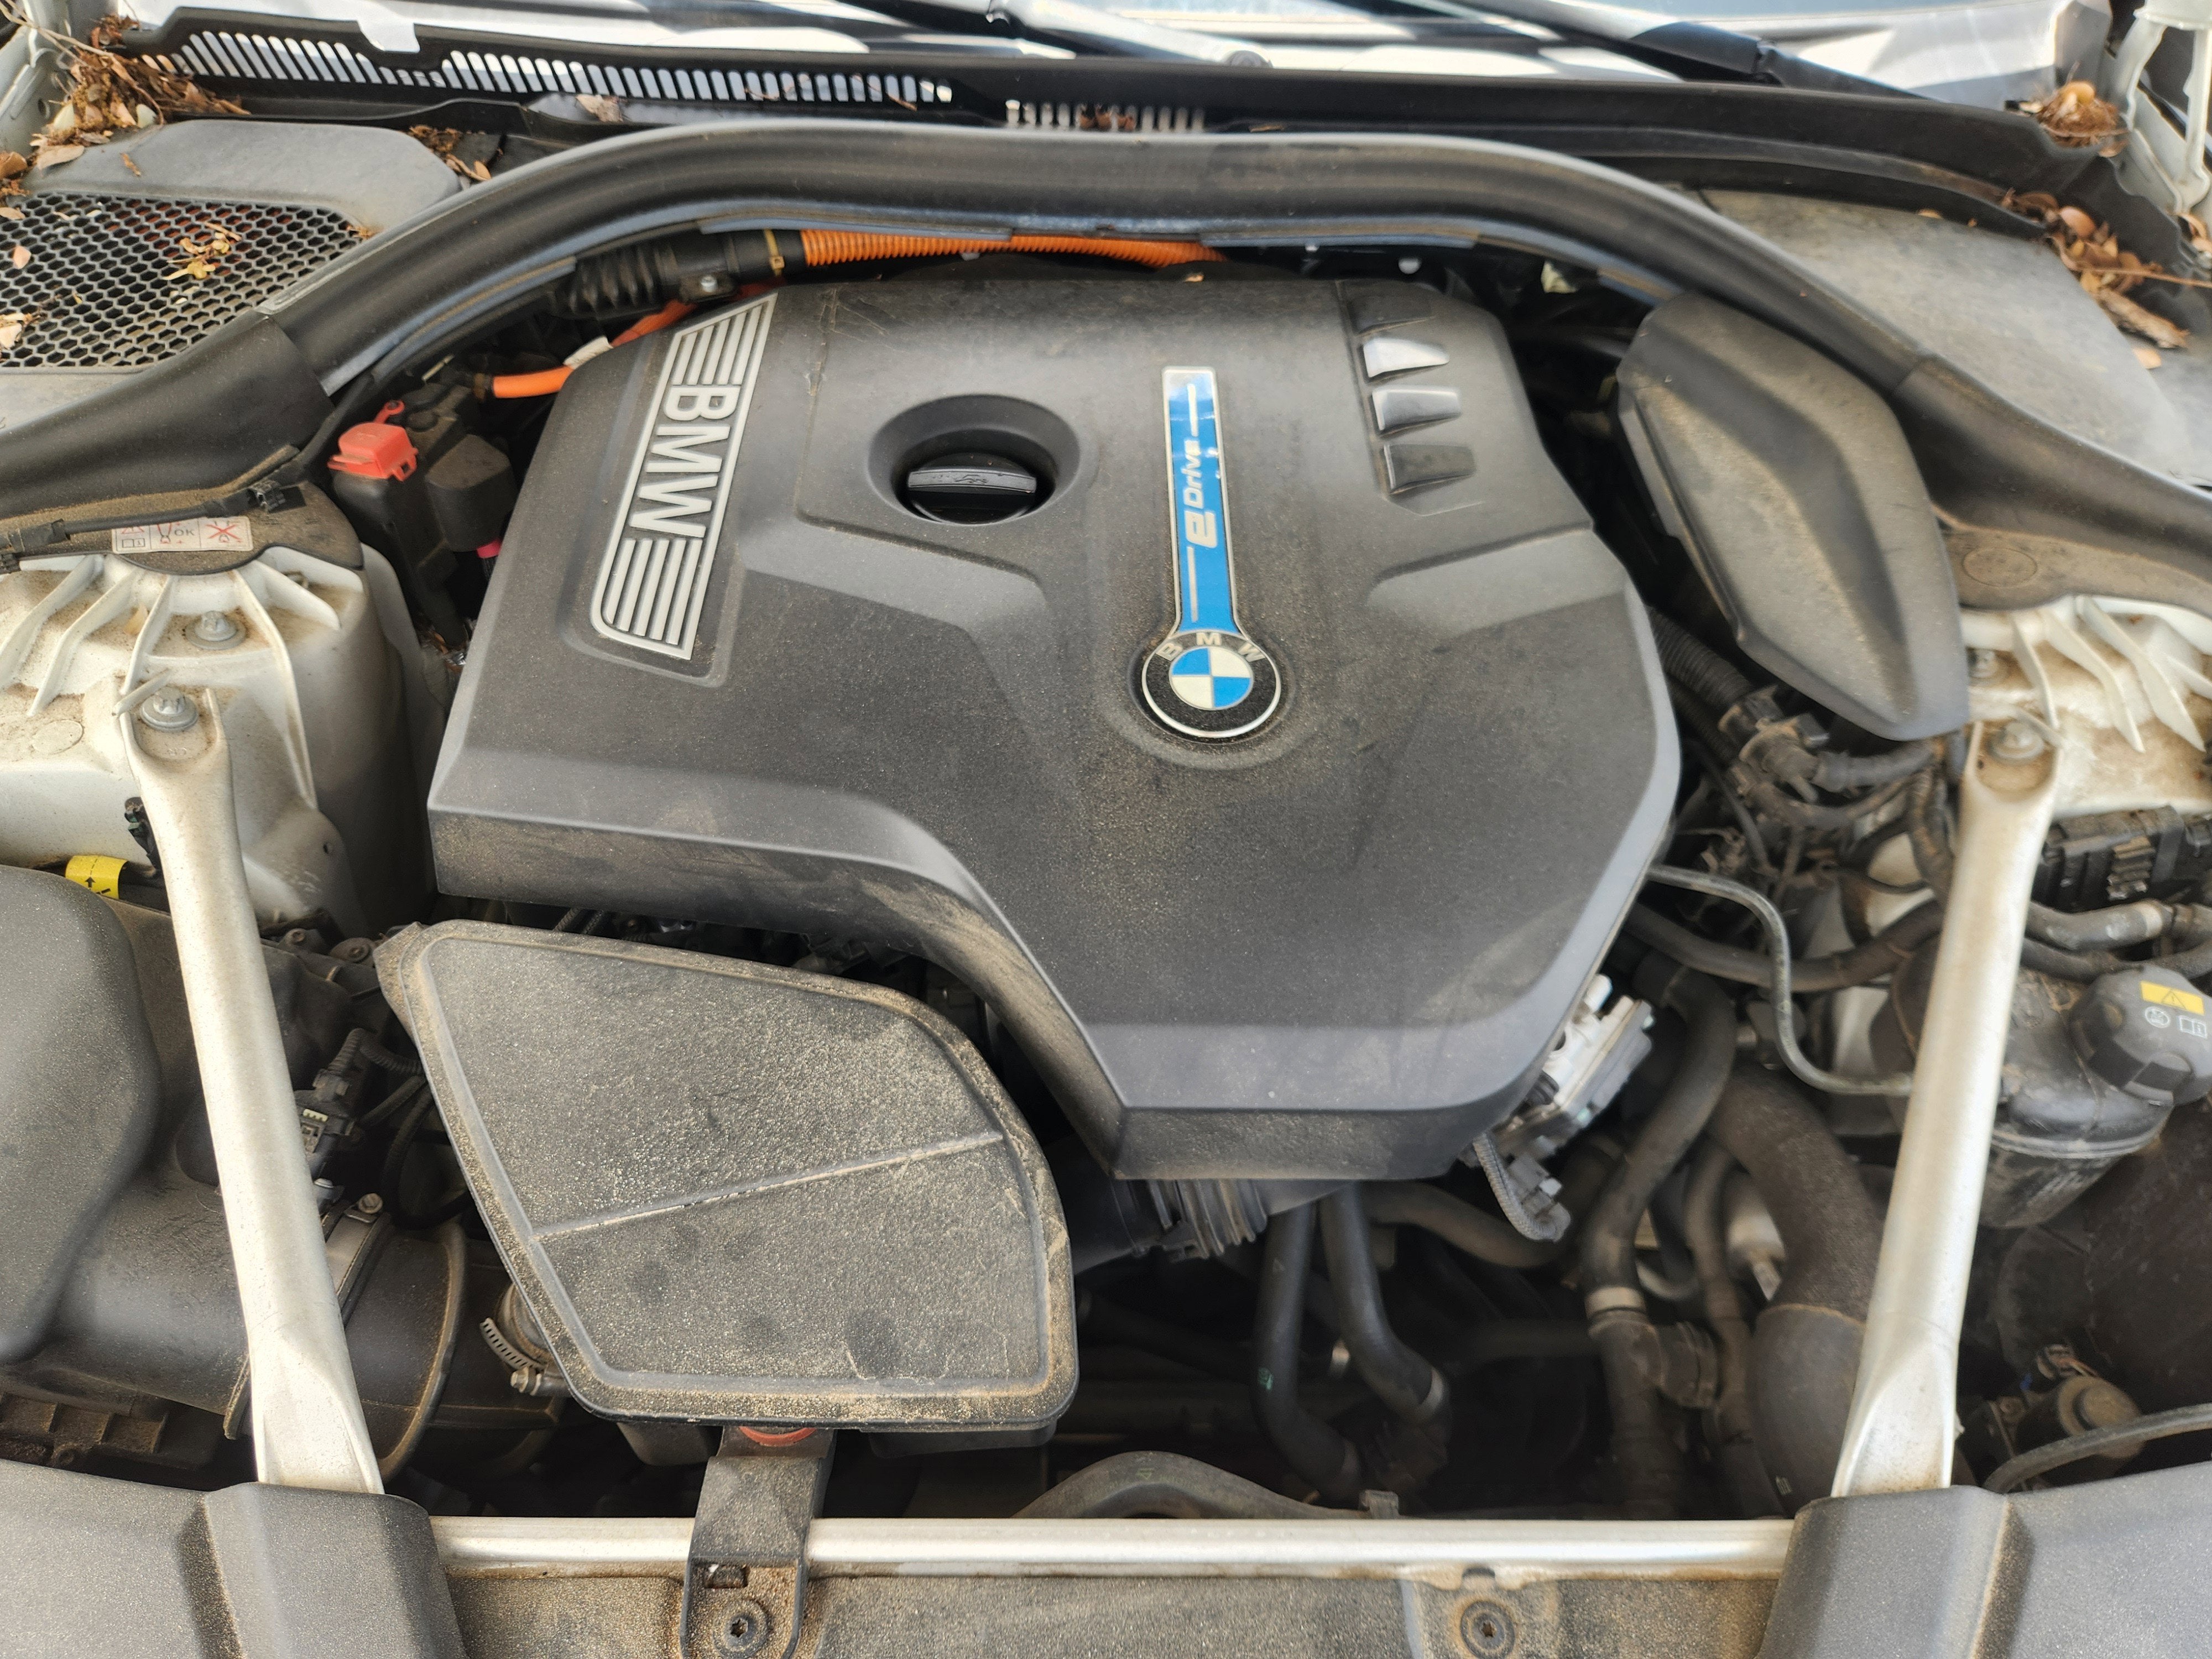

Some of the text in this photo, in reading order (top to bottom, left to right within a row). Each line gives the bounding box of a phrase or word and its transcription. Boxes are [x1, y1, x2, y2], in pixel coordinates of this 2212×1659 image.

[629, 384, 742, 538] BMW
[174, 528, 195, 537] OK
[1157, 632, 1265, 662] BMW
